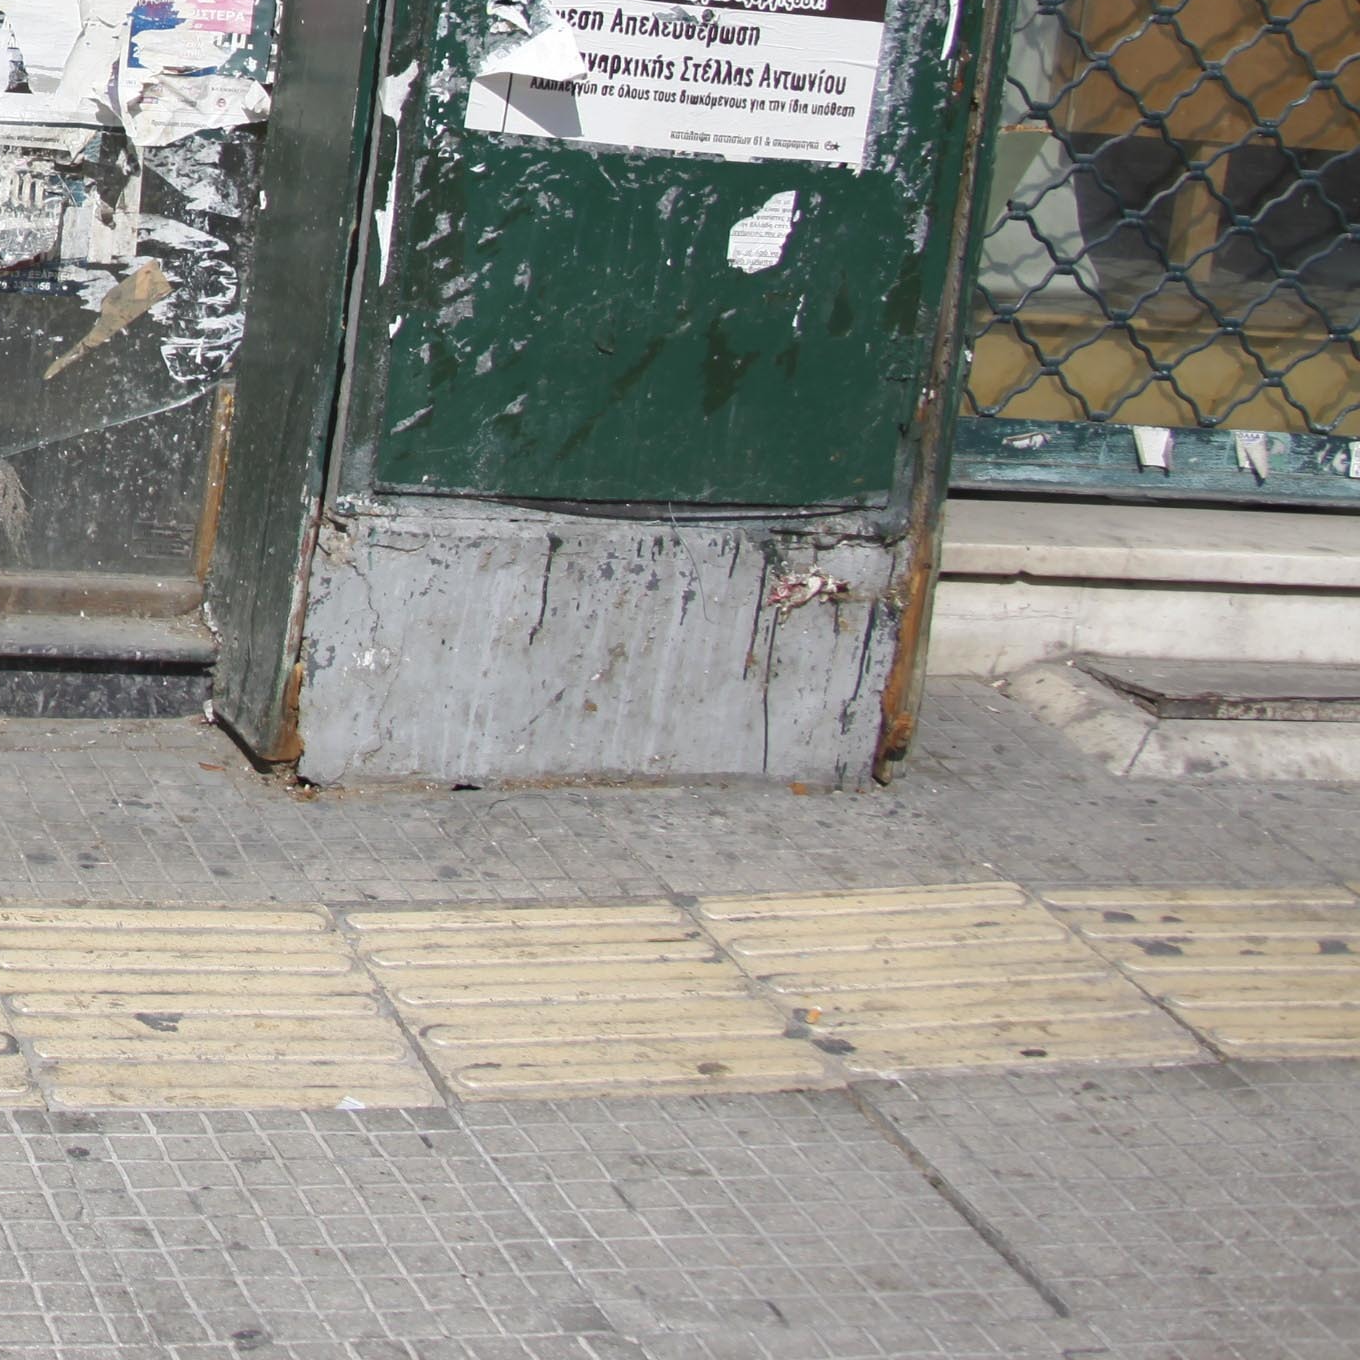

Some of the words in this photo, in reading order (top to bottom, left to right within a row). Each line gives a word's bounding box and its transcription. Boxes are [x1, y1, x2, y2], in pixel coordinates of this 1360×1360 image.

[679, 55, 754, 88] Στέλλας
[758, 63, 848, 96] Αντωνίου
[600, 86, 615, 96] σε
[617, 83, 650, 101] όλους
[652, 89, 677, 102] τους
[679, 88, 748, 111] διωκόμενους
[749, 97, 766, 113] για
[767, 97, 786, 114] την
[787, 98, 809, 114] ίδια
[810, 100, 856, 118] υπόθεση
